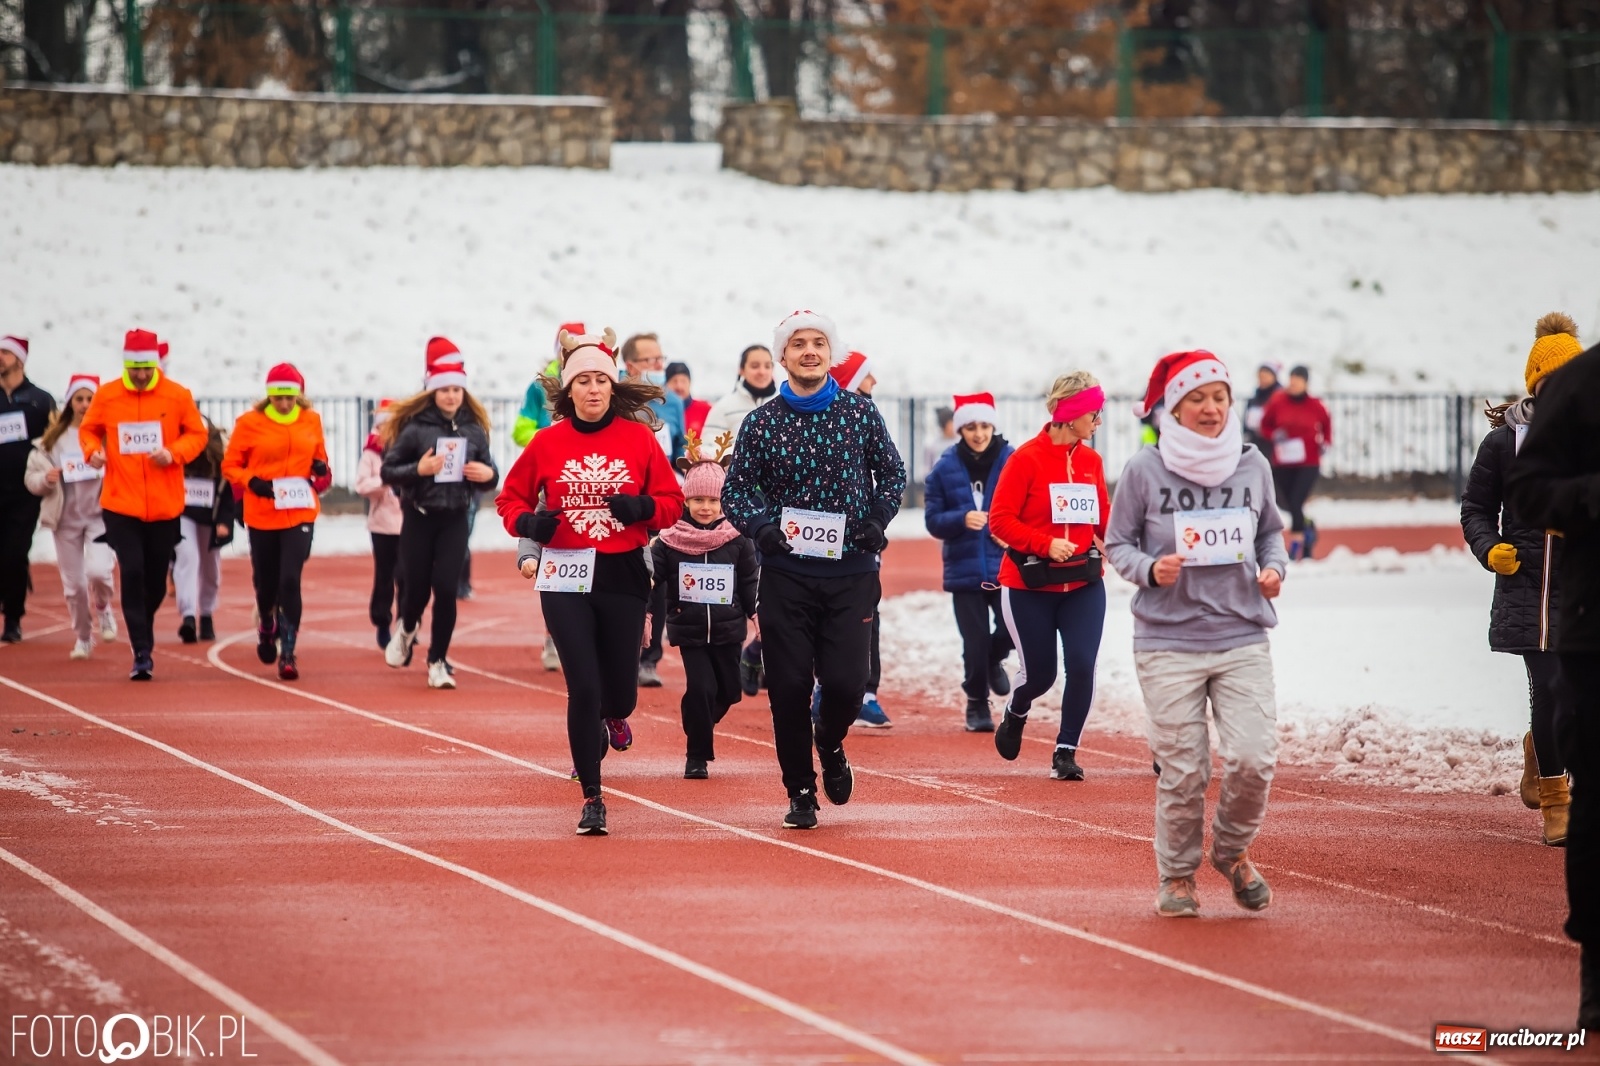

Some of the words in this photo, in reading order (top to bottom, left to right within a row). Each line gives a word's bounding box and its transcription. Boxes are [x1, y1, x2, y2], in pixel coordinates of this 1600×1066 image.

[133, 433, 157, 445] 052
[288, 489, 309, 499] 051
[567, 482, 624, 495] HAPPY
[560, 495, 610, 508] HOLID
[1070, 498, 1095, 511] 087
[802, 526, 838, 543] 026
[1204, 527, 1243, 546] 014
[558, 564, 588, 578] 028
[697, 578, 726, 591] 185
